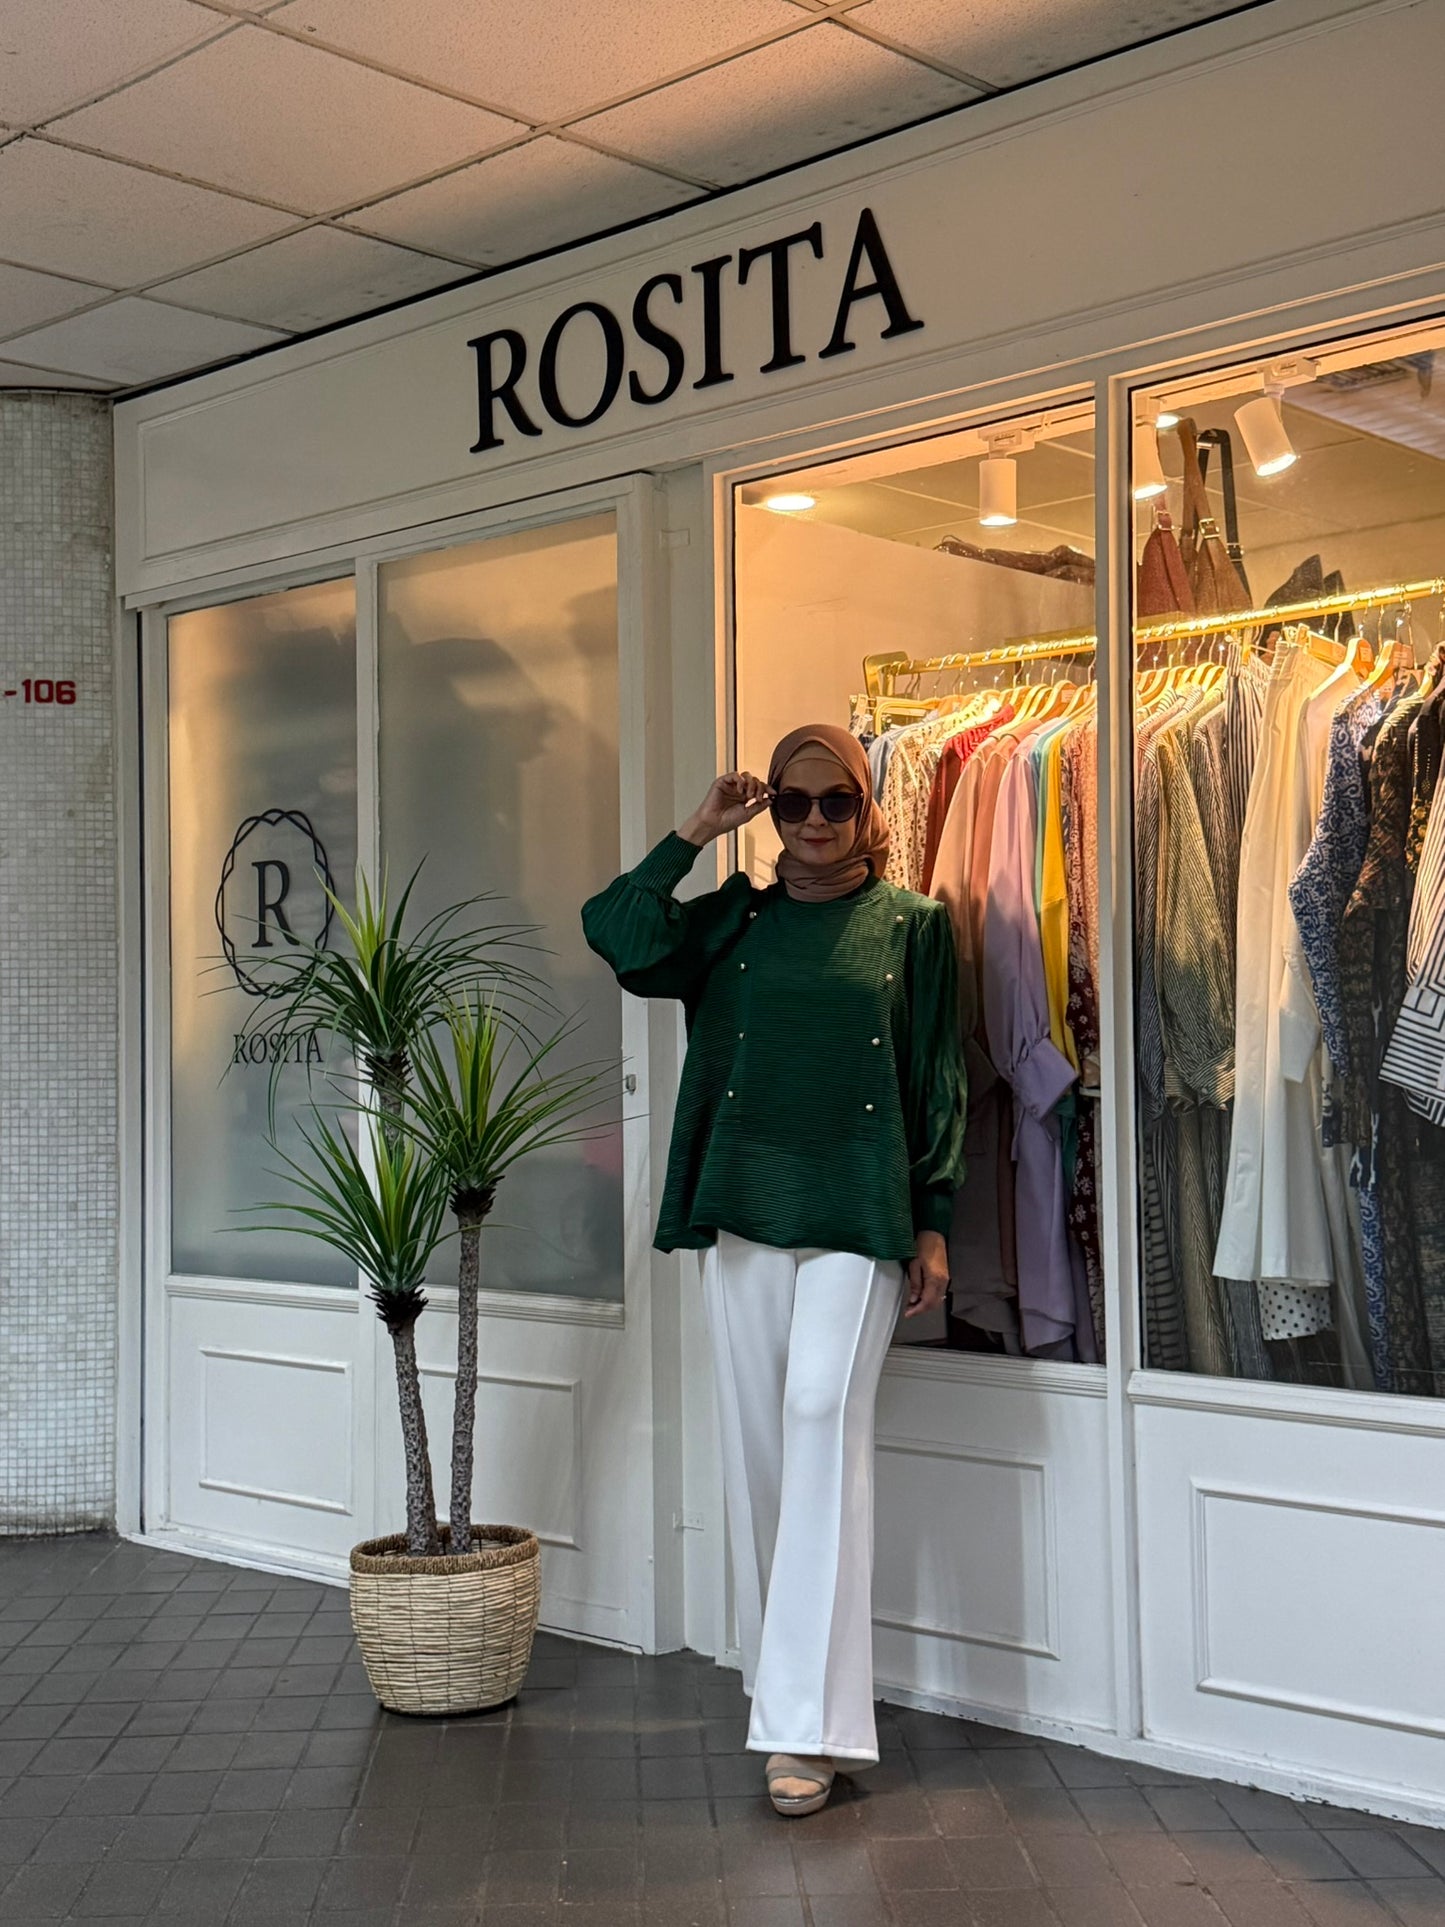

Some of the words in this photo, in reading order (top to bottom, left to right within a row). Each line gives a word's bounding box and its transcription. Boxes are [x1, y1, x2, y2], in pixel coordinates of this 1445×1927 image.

[467, 207, 925, 454] ROSITA
[4, 679, 77, 705] -106
[251, 859, 300, 948] R
